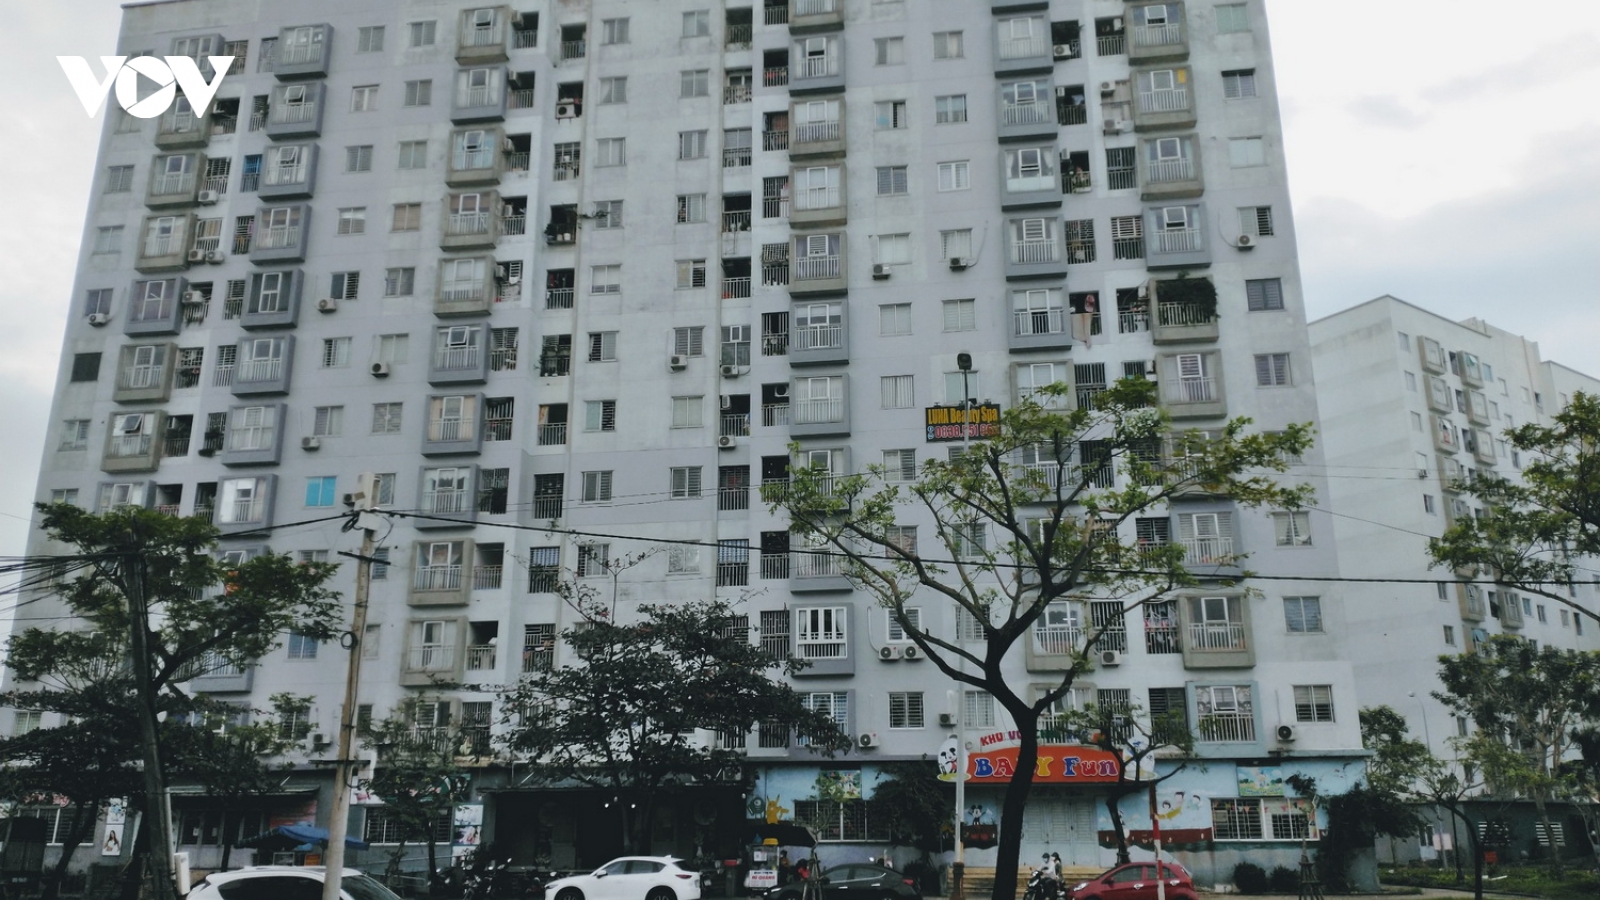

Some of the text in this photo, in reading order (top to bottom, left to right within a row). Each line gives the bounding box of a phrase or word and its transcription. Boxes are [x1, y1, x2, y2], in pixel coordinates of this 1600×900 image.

[928, 409, 949, 425] LUNA
[981, 406, 998, 423] Spa
[980, 732, 1003, 747] KHU
[974, 756, 1118, 777] BAY Fun
